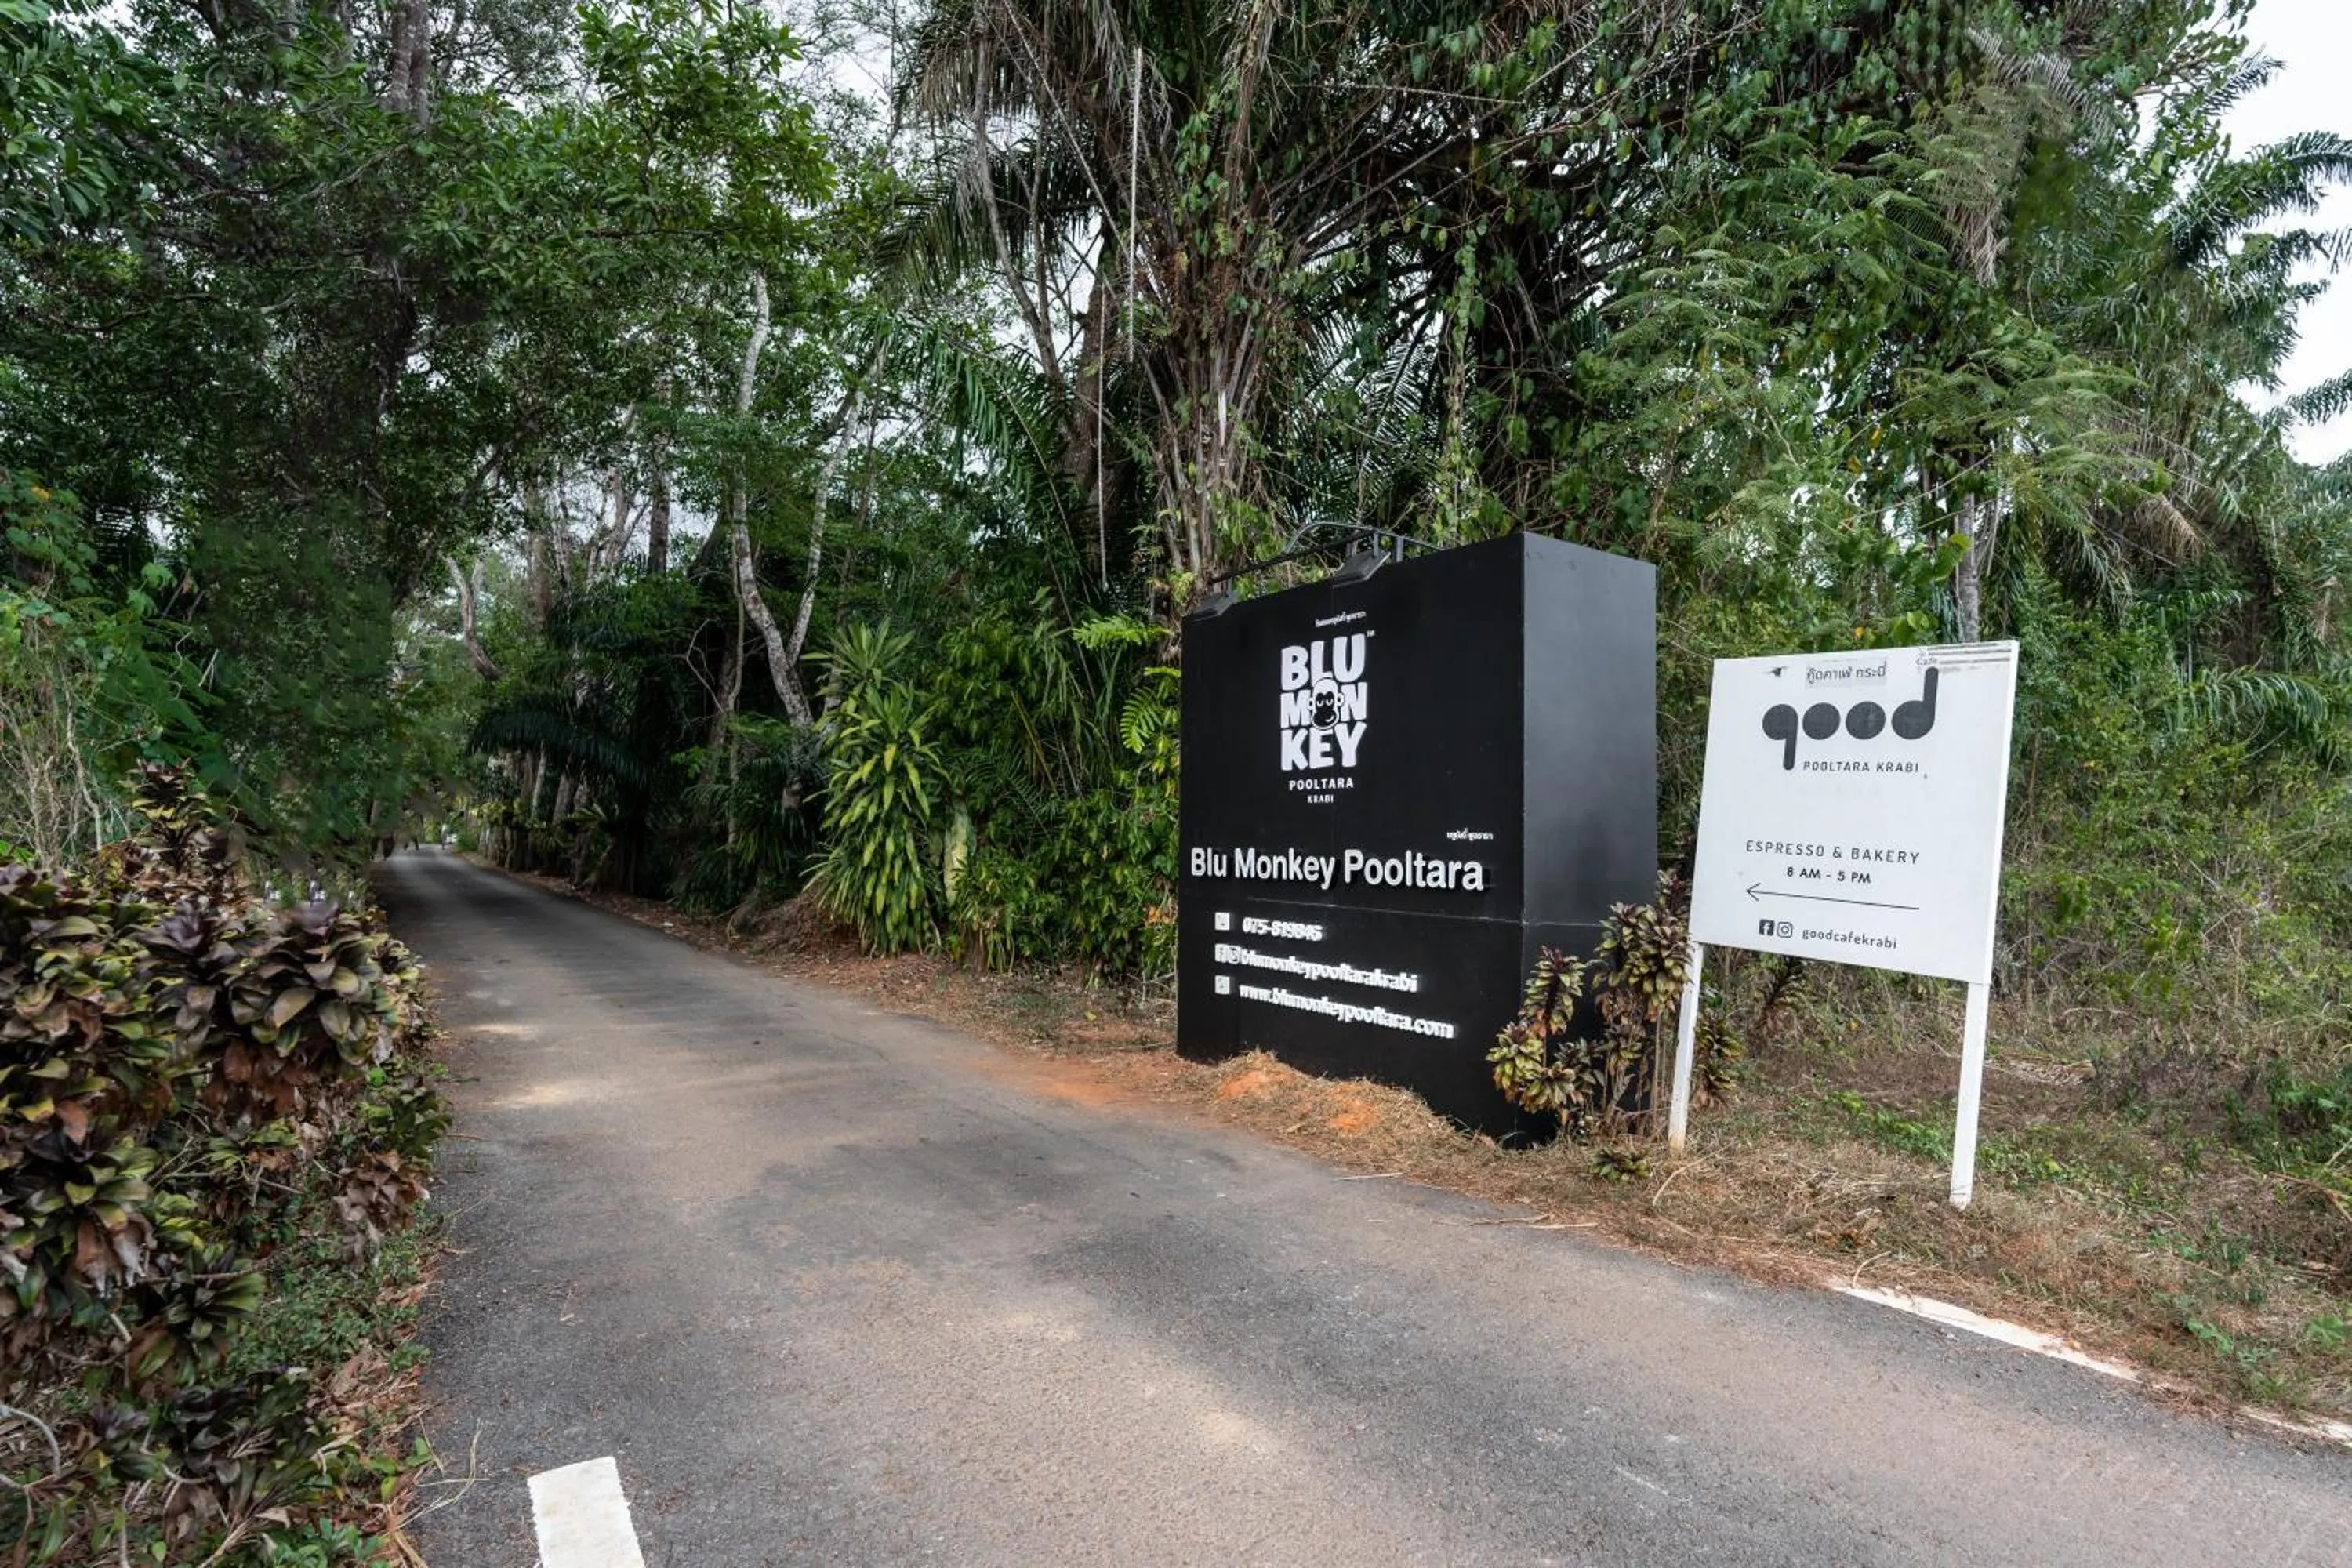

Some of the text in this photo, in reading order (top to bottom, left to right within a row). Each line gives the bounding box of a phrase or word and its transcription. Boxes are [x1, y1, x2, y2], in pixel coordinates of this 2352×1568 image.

[1281, 633, 1366, 691] BLU
[1280, 720, 1367, 771] KEY
[1803, 760, 1918, 772] POOLTARA KRABI
[1289, 777, 1354, 791] POOLTARA
[1307, 794, 1334, 804] KRABI
[1746, 840, 1920, 864] ESPRESSO & BAKERY
[1191, 847, 1484, 891] Blu Monkey Pooltara
[1786, 866, 1794, 877] 8
[1799, 867, 1821, 879] AM
[1837, 870, 1846, 882] 5
[1851, 871, 1871, 884] PM
[1802, 928, 1897, 949] goodcafekrabi
